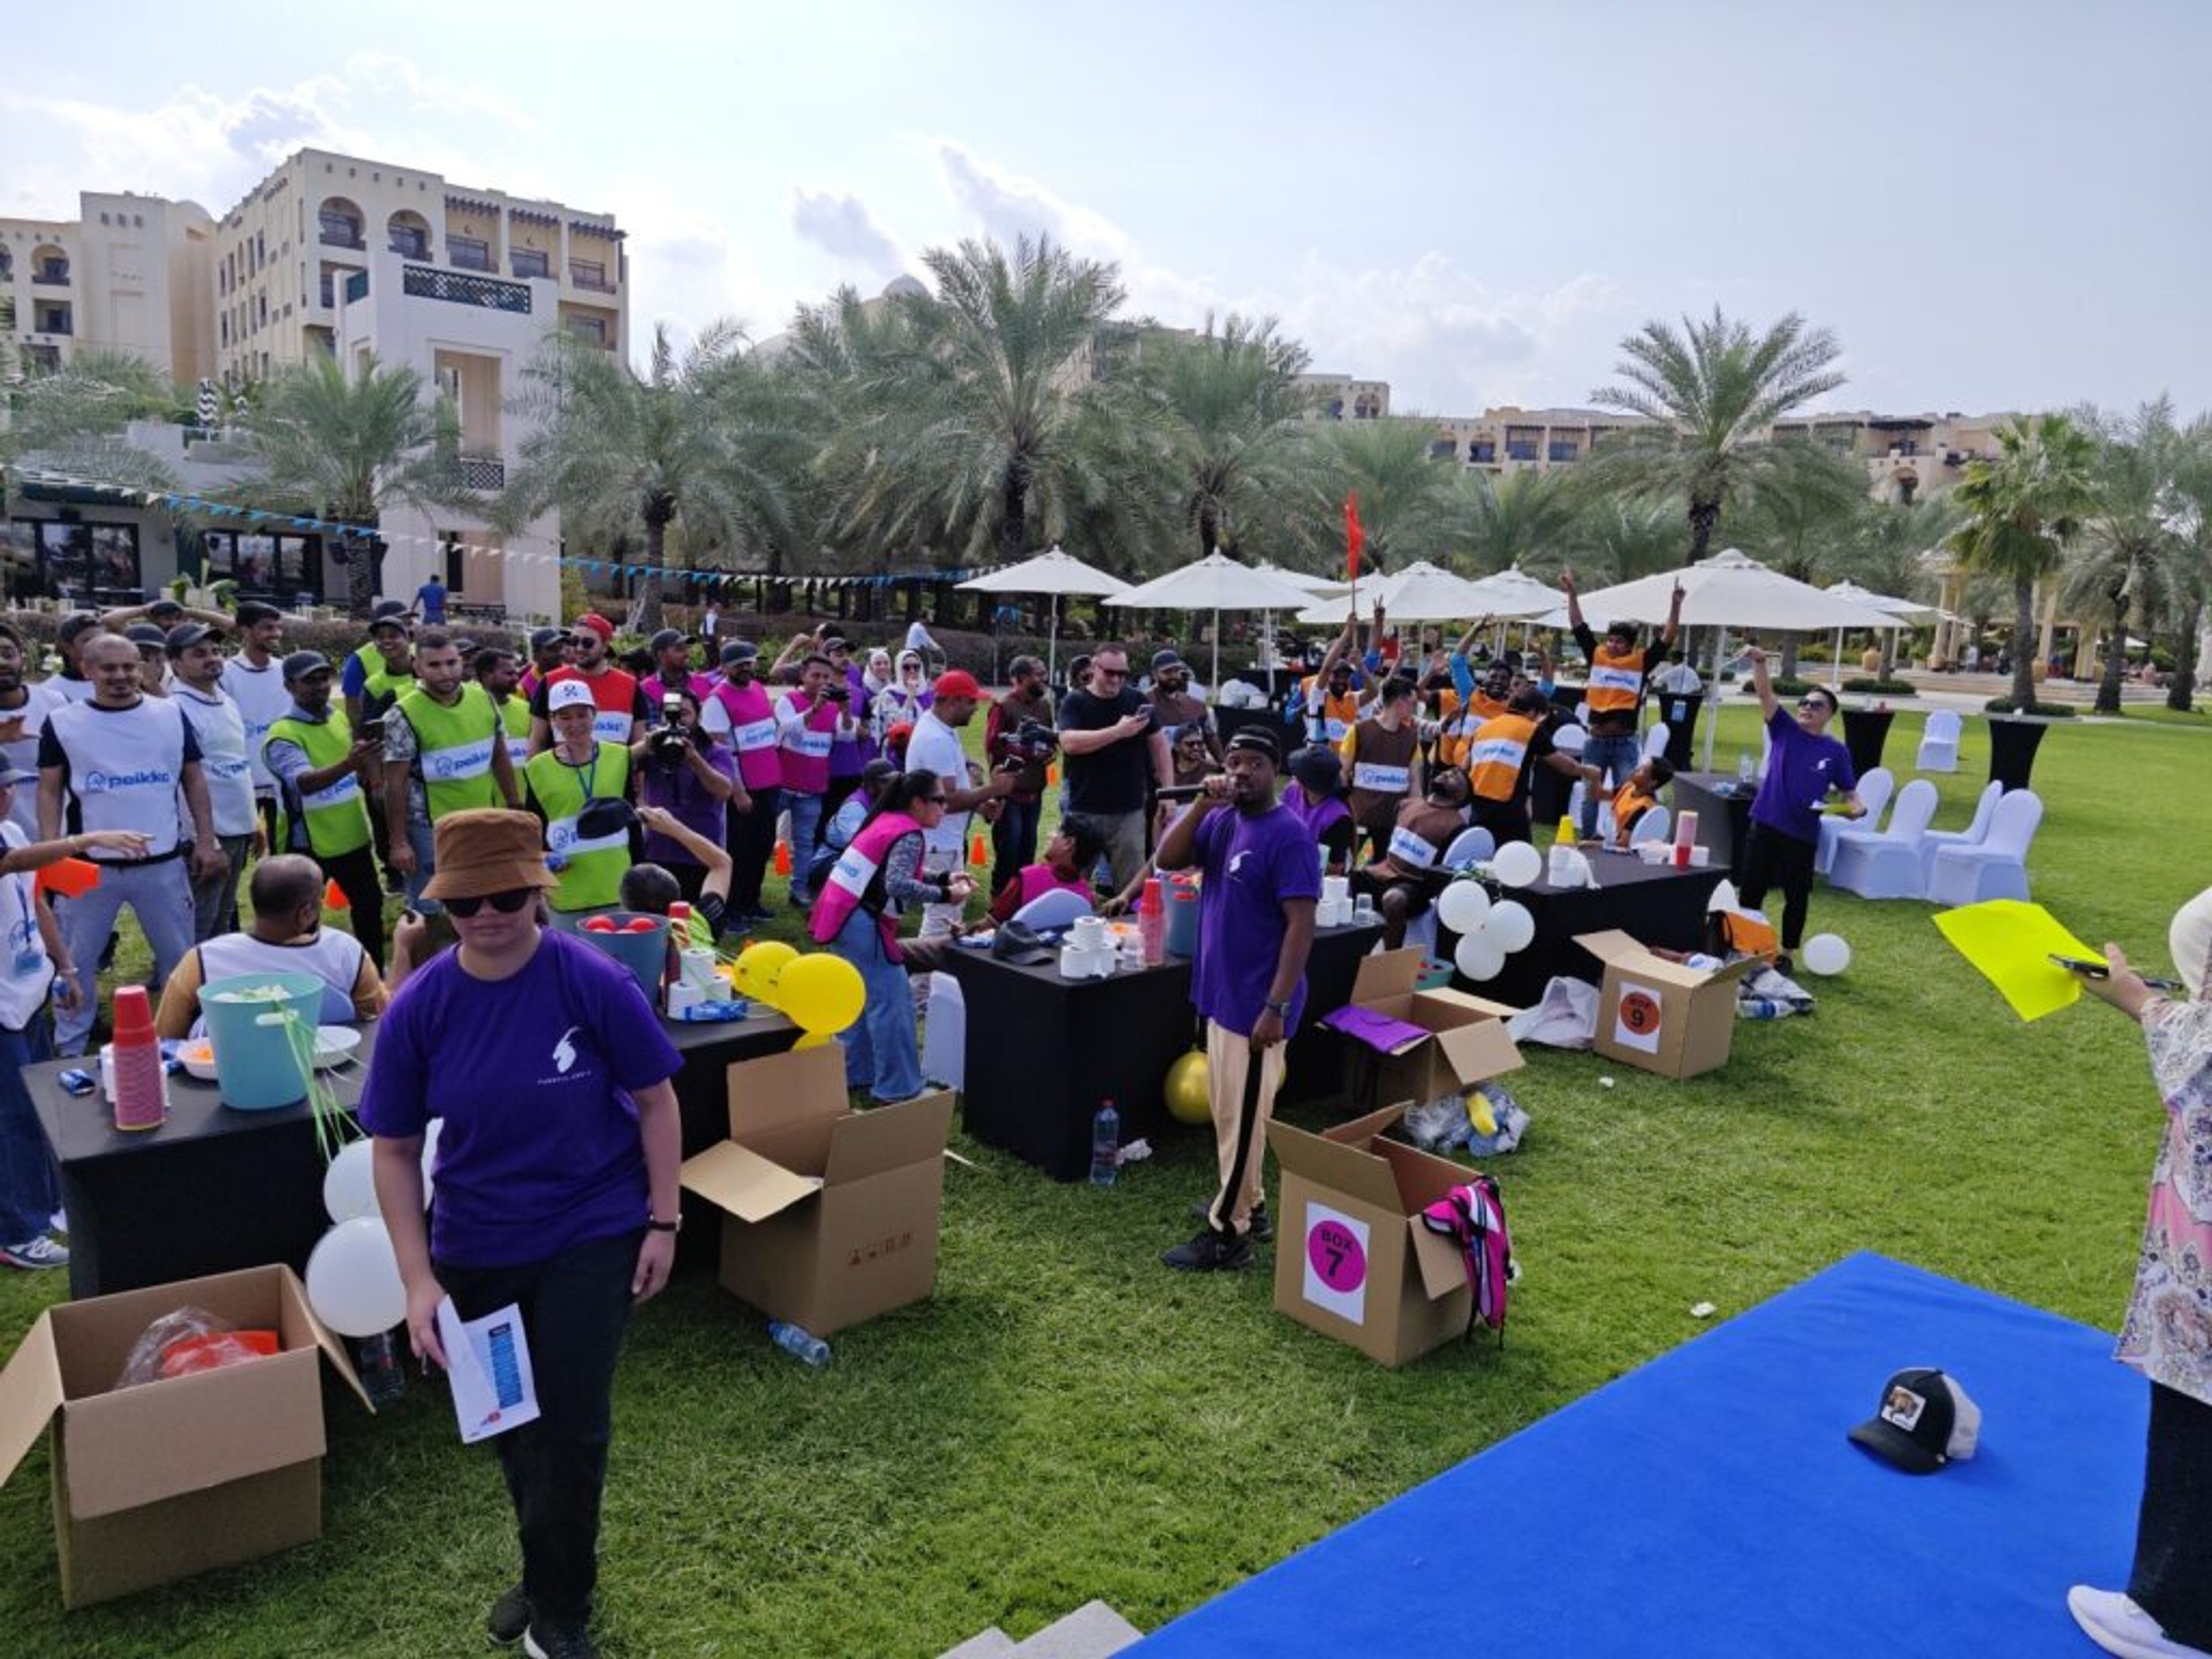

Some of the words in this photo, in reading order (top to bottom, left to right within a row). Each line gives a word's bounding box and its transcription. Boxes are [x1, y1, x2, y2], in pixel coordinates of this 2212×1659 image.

[1631, 1008, 1645, 1028] 9
[1321, 1228, 1353, 1253] BOX
[1326, 1246, 1344, 1278] 7
